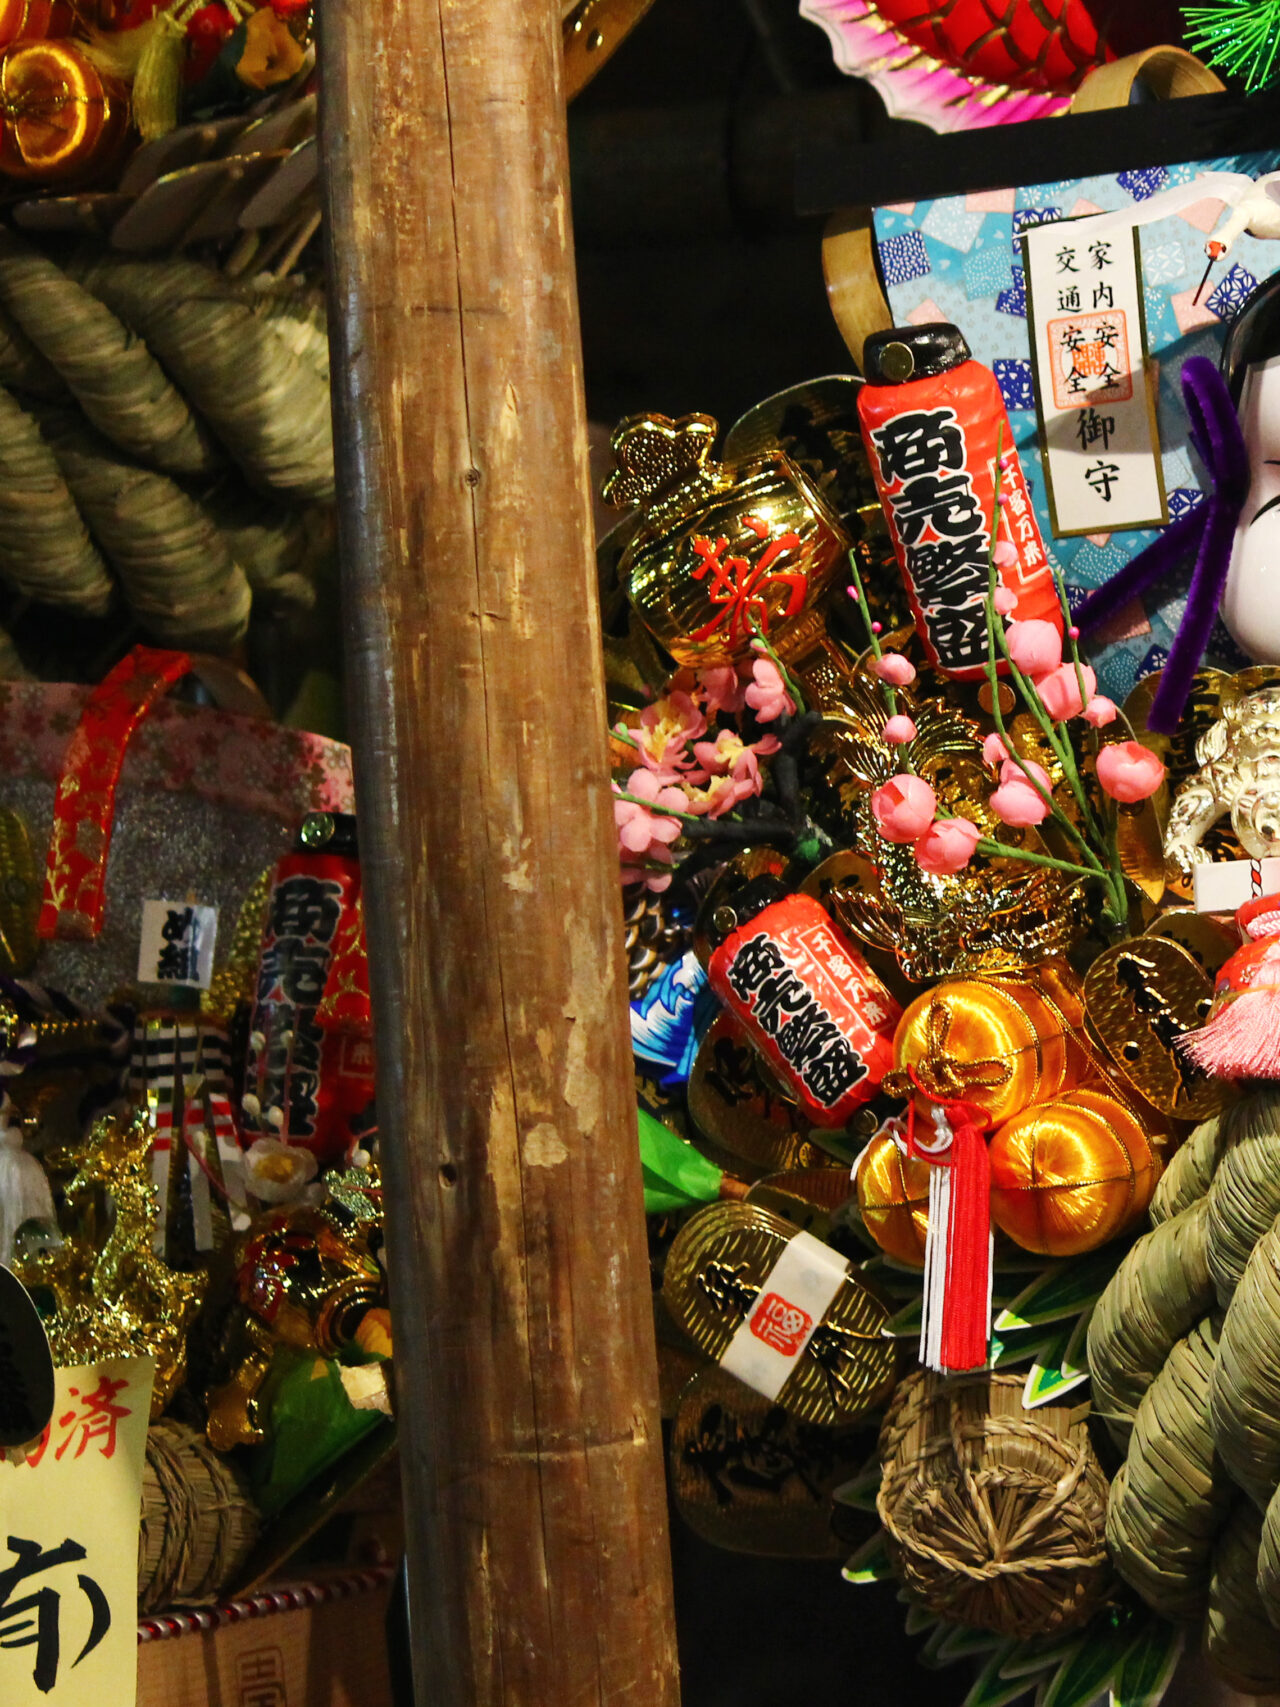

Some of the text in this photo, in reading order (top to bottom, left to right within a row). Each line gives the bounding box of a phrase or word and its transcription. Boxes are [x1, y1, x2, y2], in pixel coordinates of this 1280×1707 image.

[1056, 246, 1088, 394] 交通安全
[1088, 241, 1121, 389] 家内安全
[1075, 408, 1121, 502] 御守
[1002, 464, 1043, 567] 千客万来
[811, 931, 887, 1026] 千客万来
